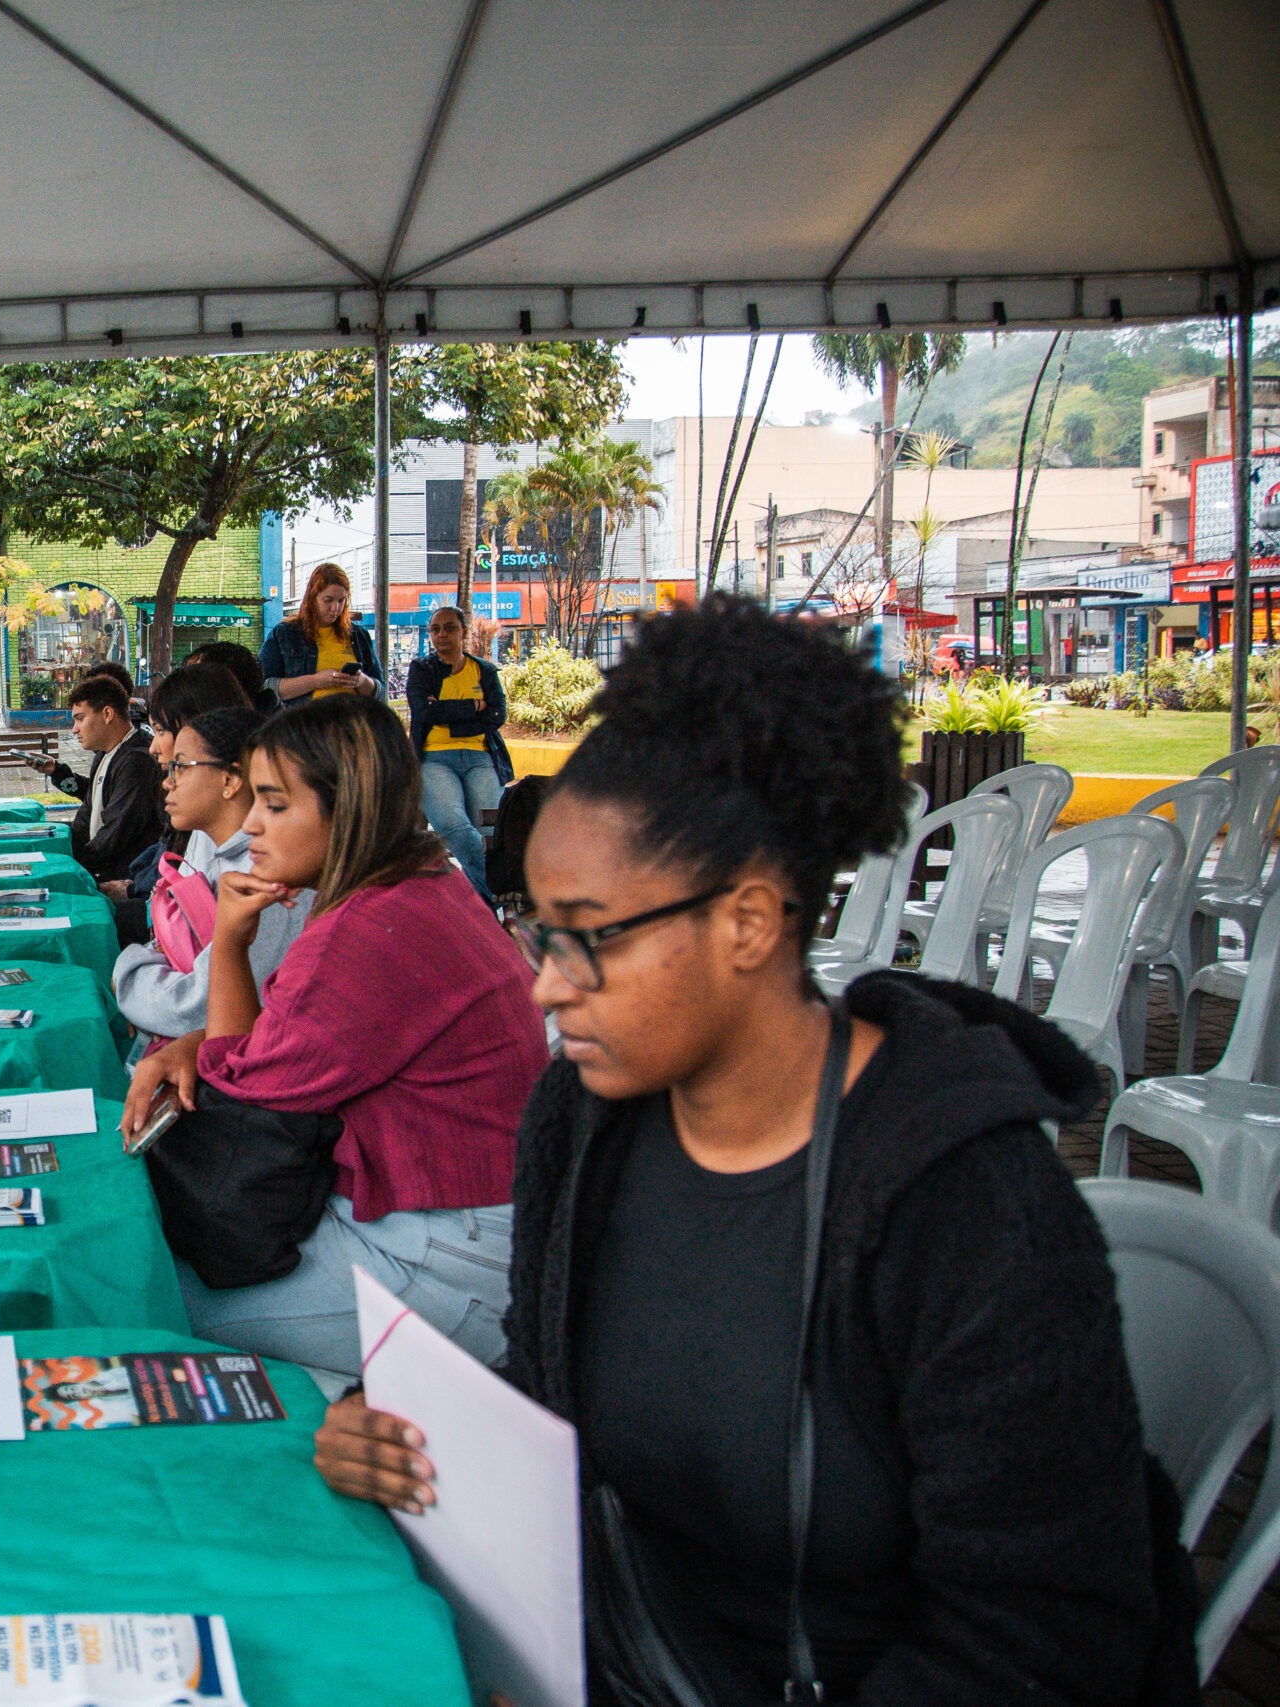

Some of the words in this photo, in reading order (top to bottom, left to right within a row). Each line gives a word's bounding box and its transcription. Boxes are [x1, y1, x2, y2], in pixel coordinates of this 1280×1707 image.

[1085, 571, 1150, 590] Botelho
[477, 602, 514, 610] CHIRO
[615, 591, 655, 606] Smat
